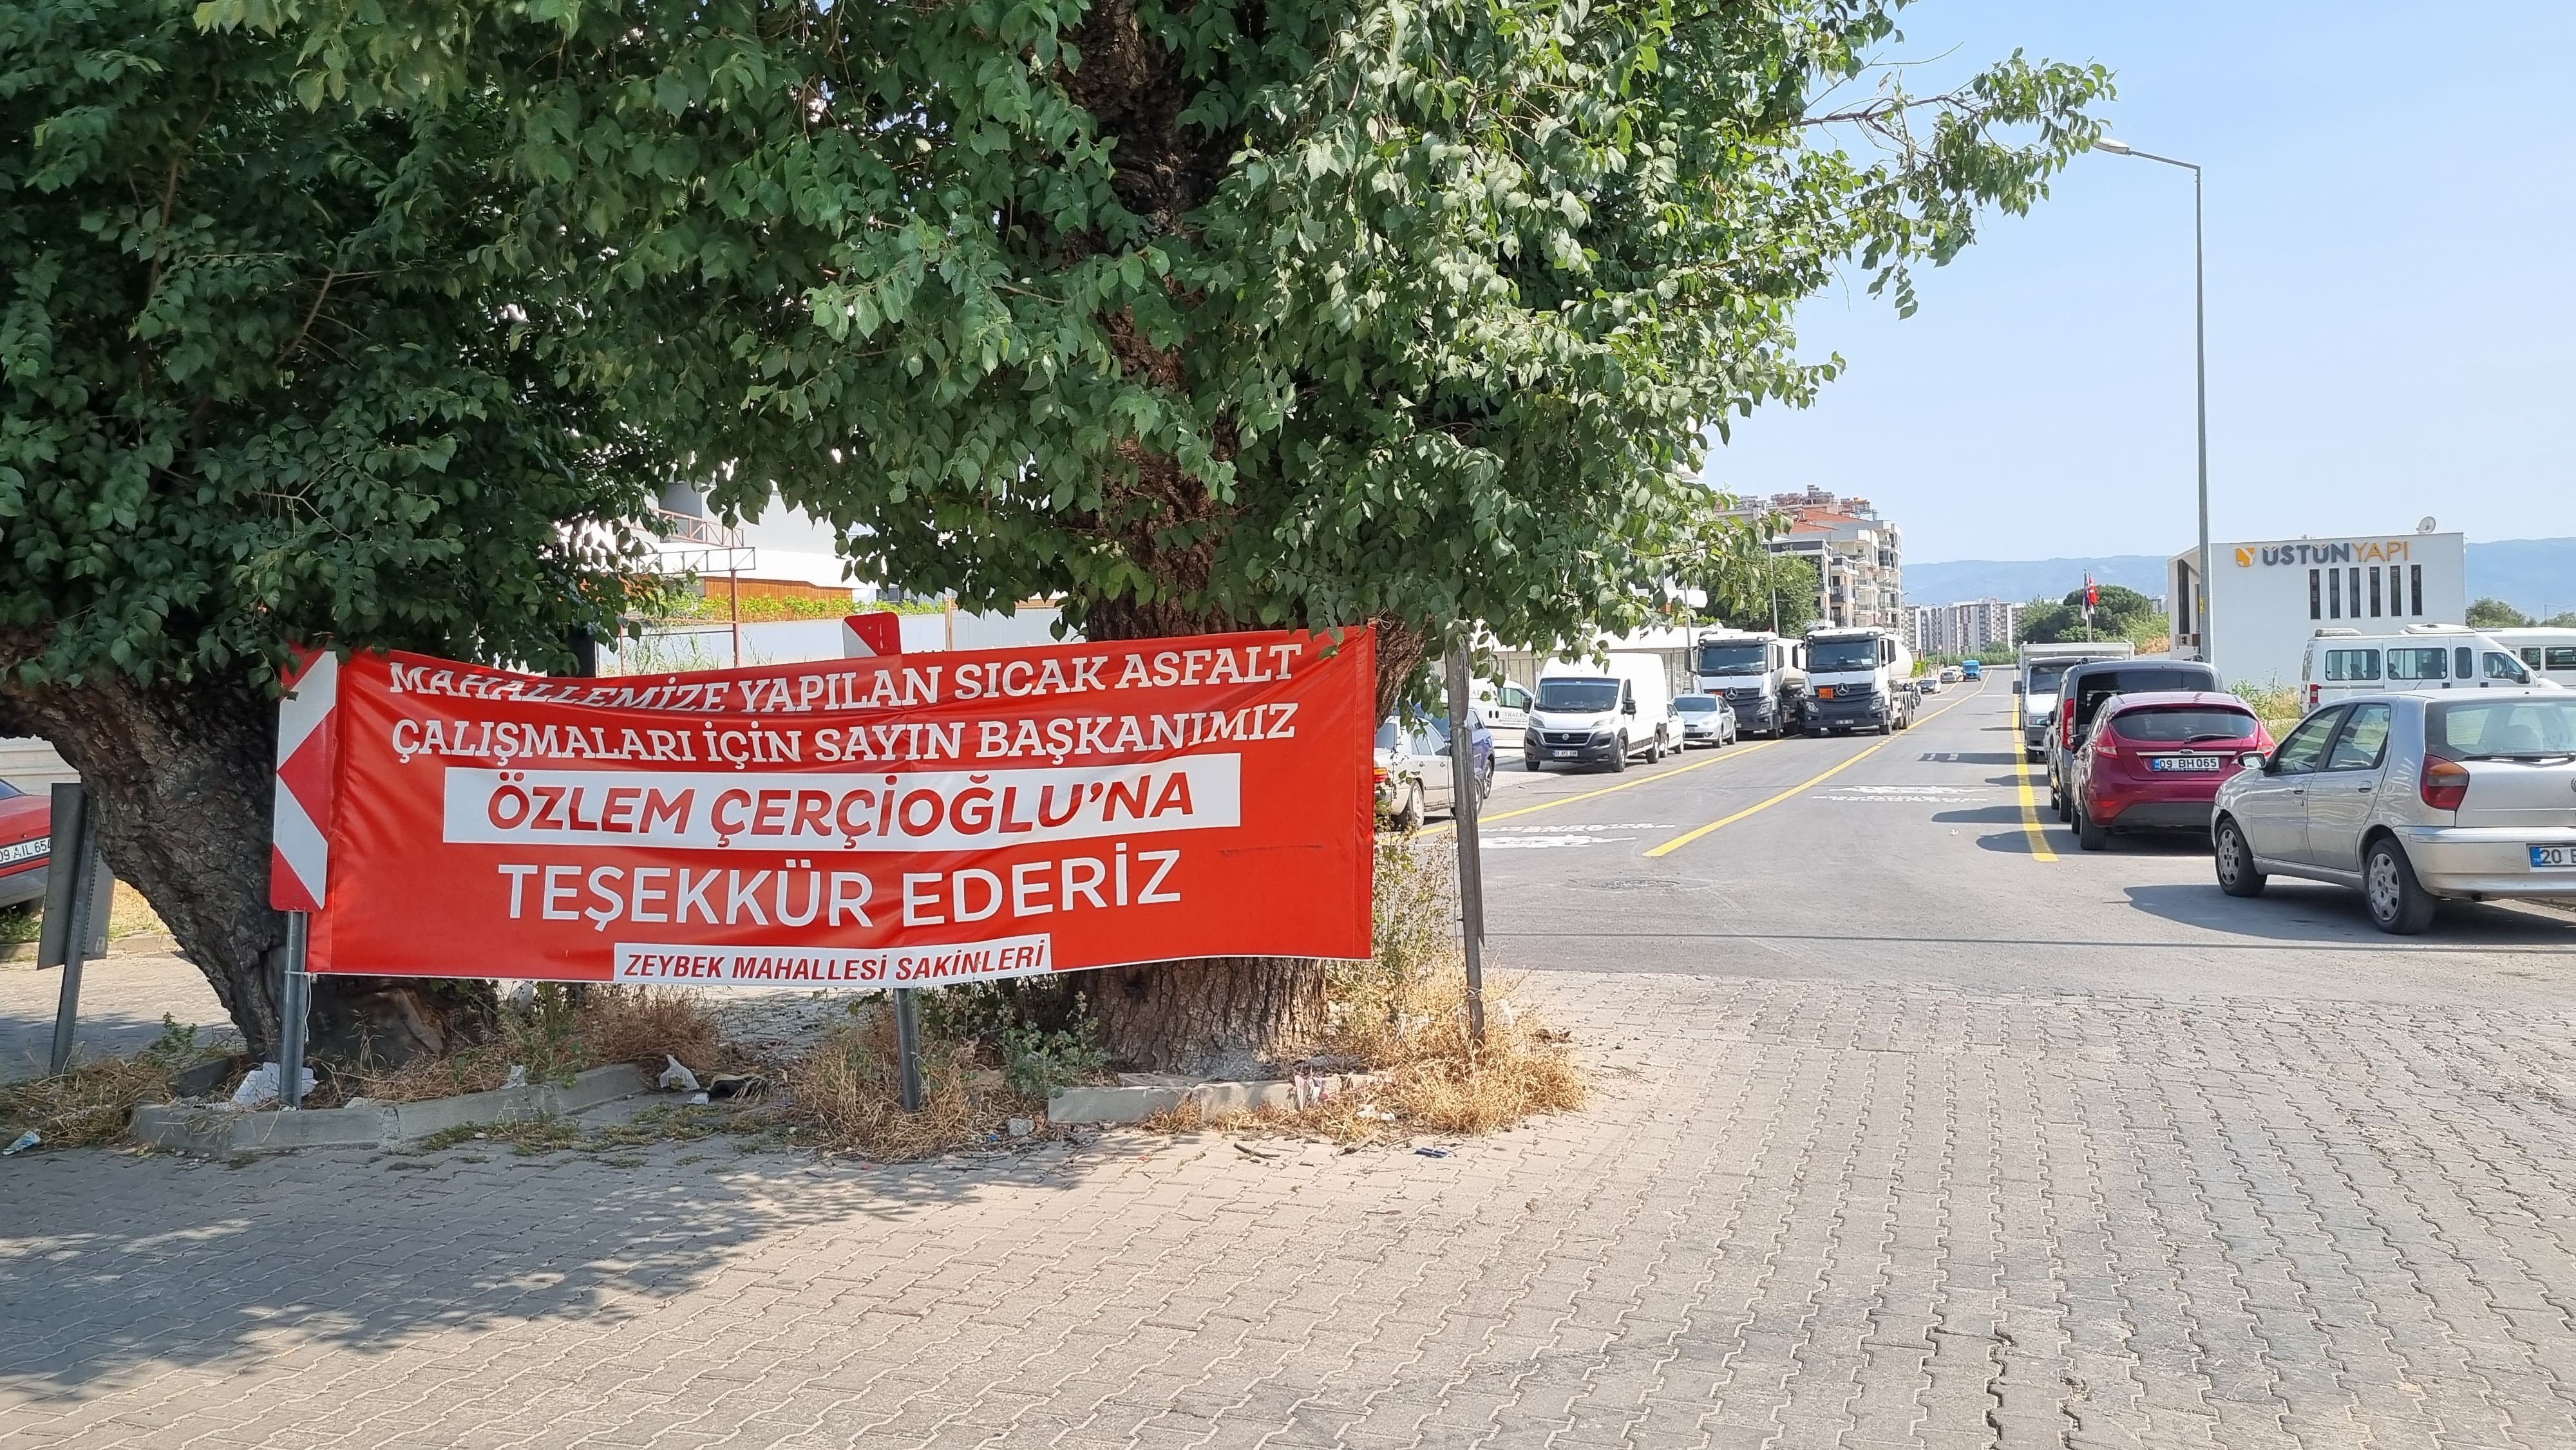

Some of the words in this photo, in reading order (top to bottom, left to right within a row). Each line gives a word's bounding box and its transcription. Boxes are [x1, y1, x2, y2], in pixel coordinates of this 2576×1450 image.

[389, 662, 729, 713] MAHALLEMİZE
[737, 666, 942, 713] YAPILAN
[954, 656, 1108, 699] SICAK
[1115, 644, 1303, 690] ASFALT
[392, 719, 695, 766] ÇALIŞMALARI
[703, 720, 802, 769] İÇİN
[815, 722, 967, 763] SAYIN
[976, 702, 1298, 765] BAŞKANIMIZ
[2159, 760, 2172, 768] 09
[2178, 759, 2194, 768] BH
[2196, 758, 2217, 767] 065
[488, 771, 696, 835] ÖZLEM
[498, 859, 874, 932] TEŞEKKÜR
[903, 842, 1181, 927] EDERİZ
[2540, 849, 2562, 864] 20
[623, 953, 723, 979] ZEYBEK
[732, 954, 887, 981] MAHALLESİ
[895, 939, 1045, 981] SAKİNLERİ
